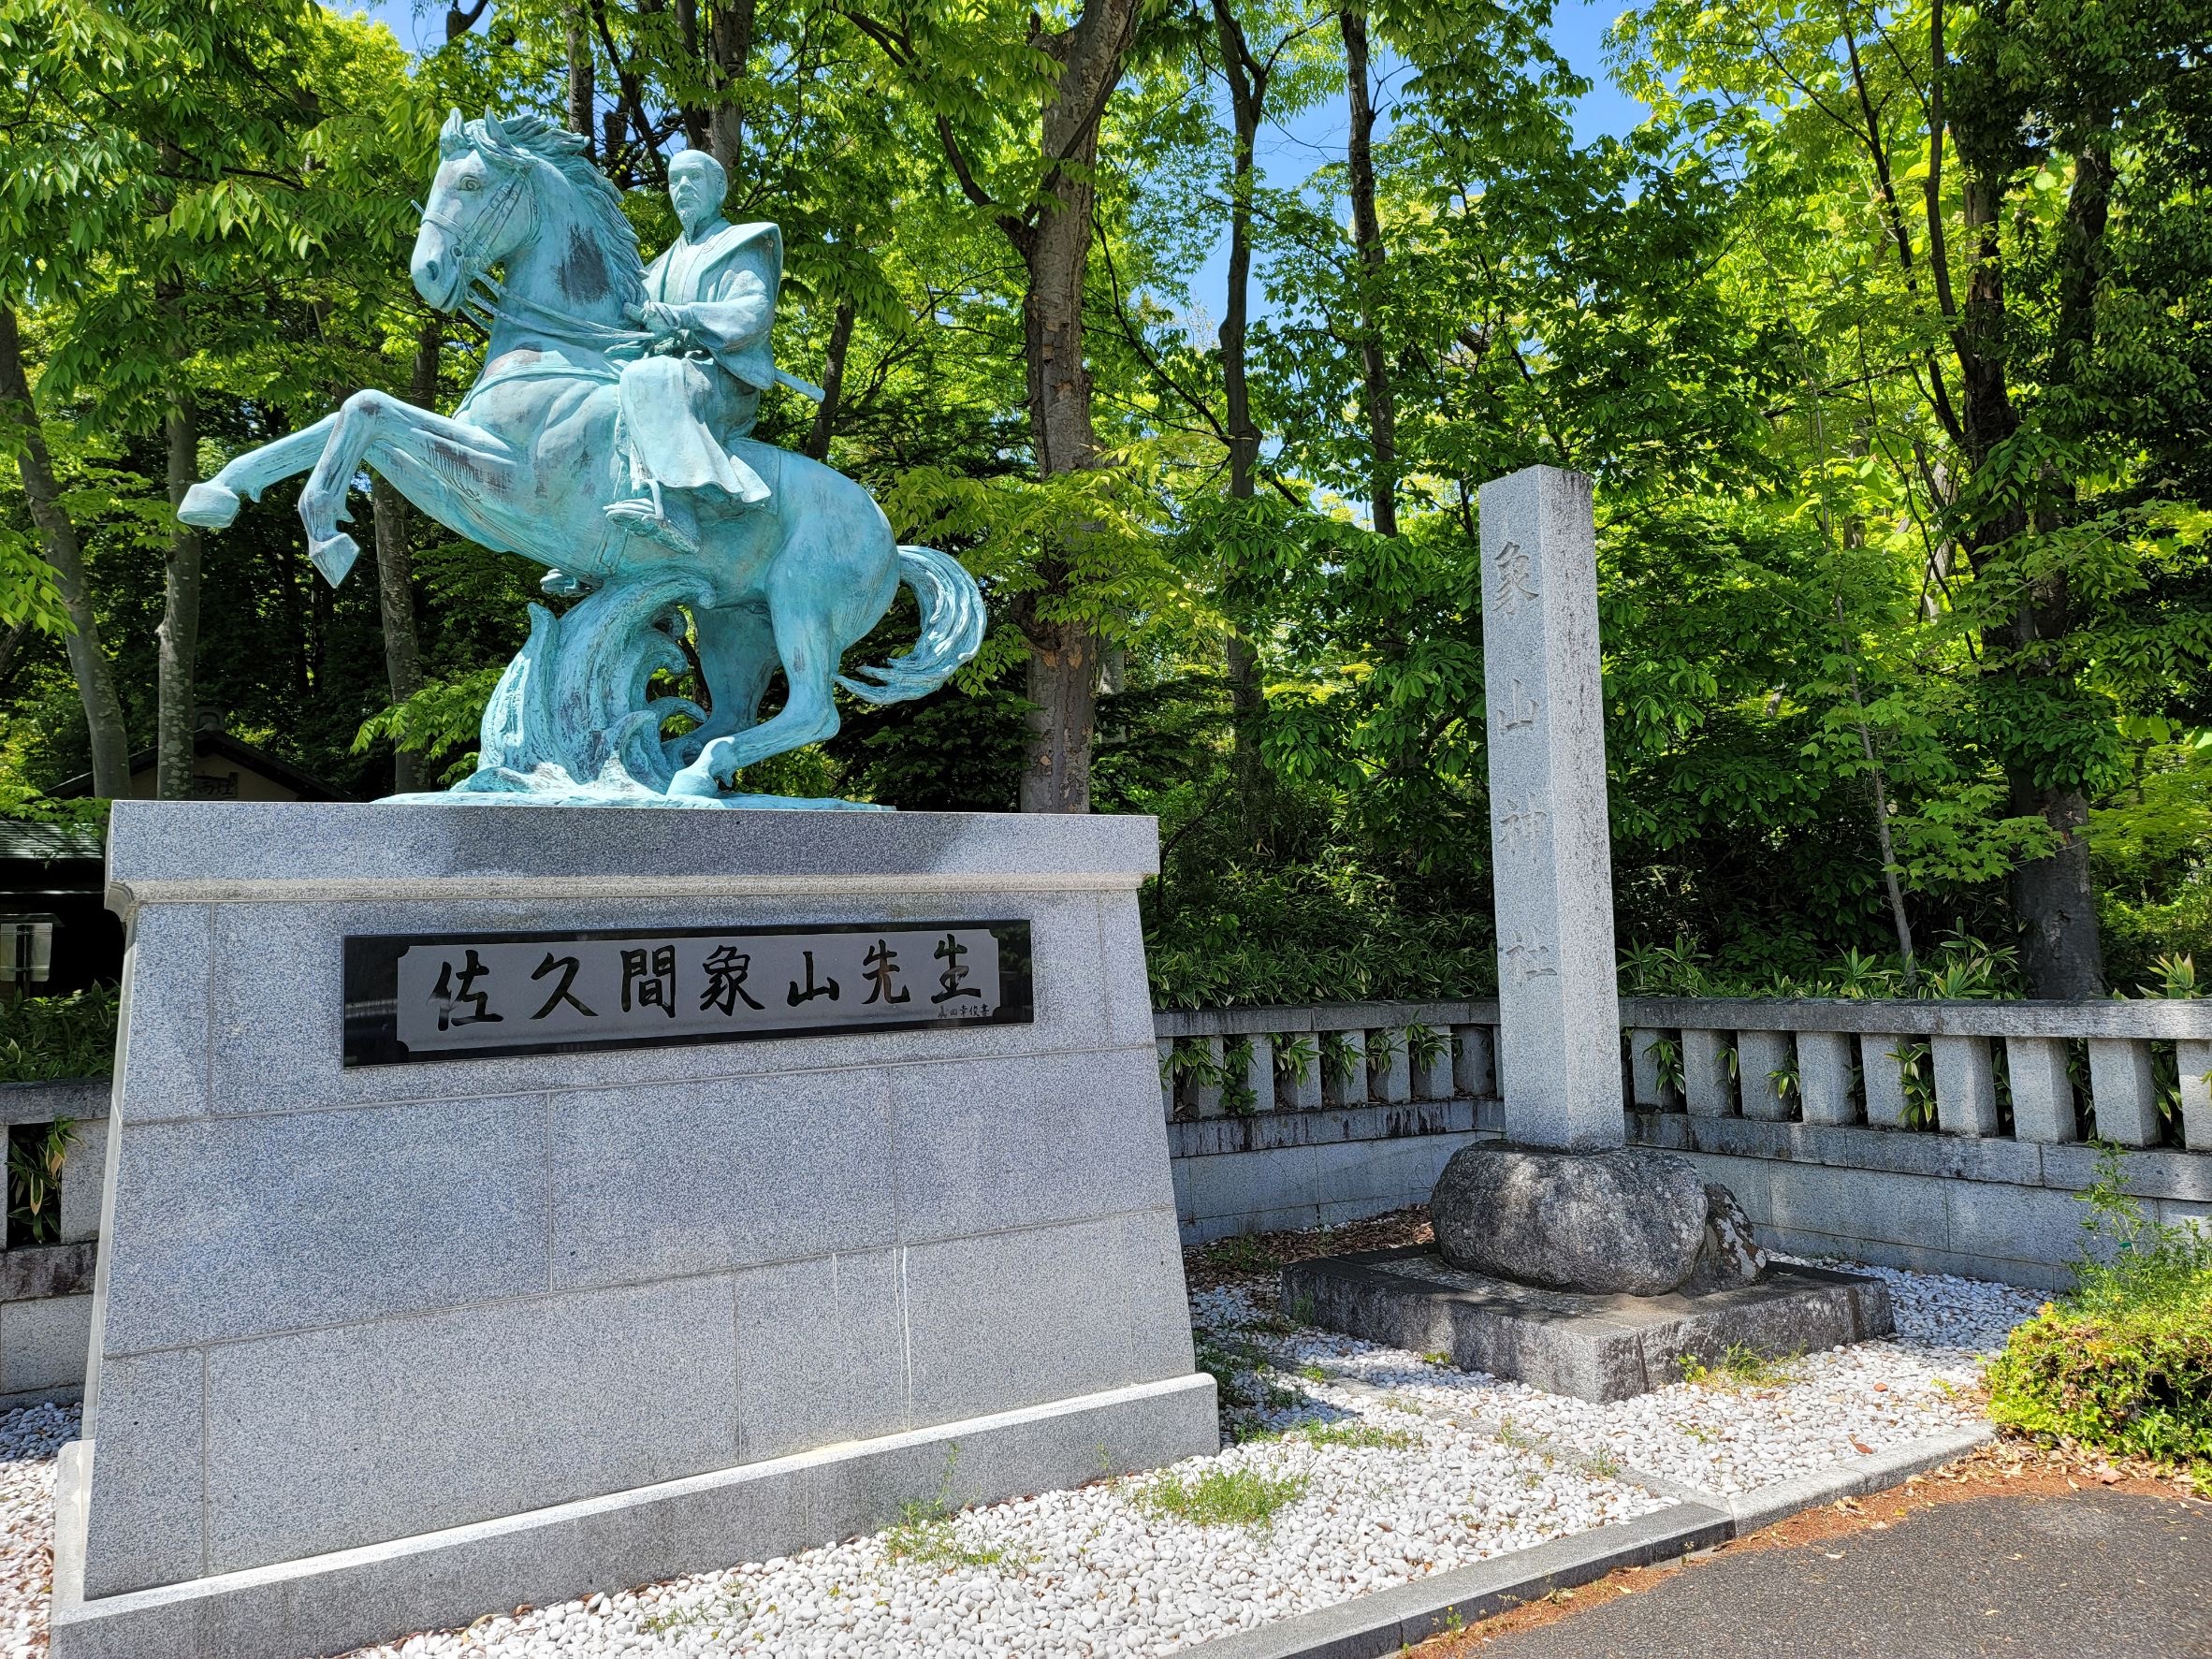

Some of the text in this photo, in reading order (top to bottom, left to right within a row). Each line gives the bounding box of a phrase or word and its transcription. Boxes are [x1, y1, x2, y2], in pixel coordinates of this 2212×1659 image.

[1492, 541, 1558, 981] 象山神社
[427, 934, 981, 1031] 佐久間象山先生
